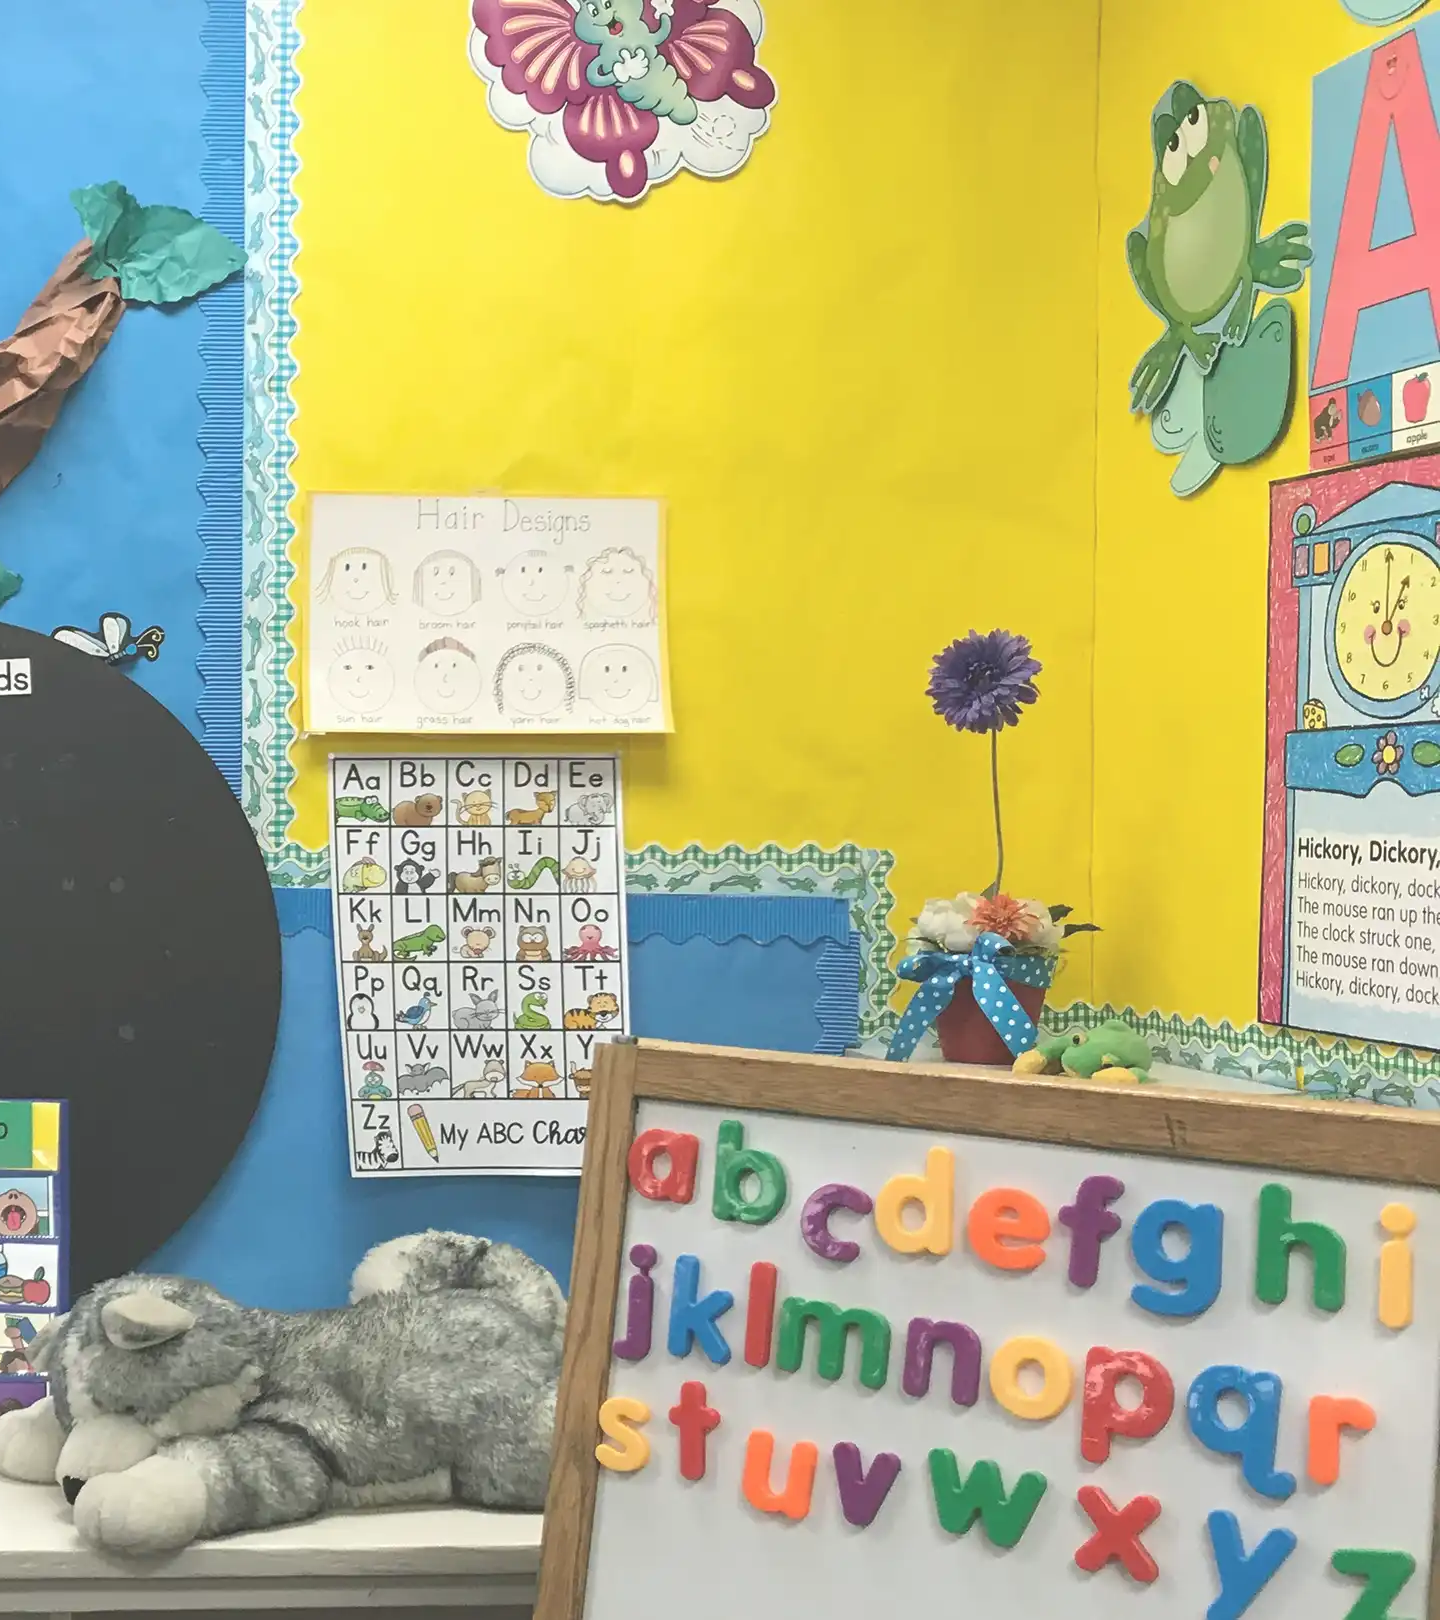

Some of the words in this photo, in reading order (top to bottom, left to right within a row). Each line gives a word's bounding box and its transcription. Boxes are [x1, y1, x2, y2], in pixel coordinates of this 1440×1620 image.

[1406, 429, 1428, 445] apple
[416, 499, 485, 532] Hair
[502, 499, 591, 545] Designs
[1348, 590, 1356, 601] 10
[1431, 577, 1437, 588] 2
[334, 616, 360, 628] hook
[367, 616, 389, 627] hair
[419, 619, 453, 630] broom
[457, 620, 476, 629] hair
[545, 620, 564, 629] hair
[631, 619, 651, 628] hair
[1340, 622, 1346, 633] 9
[1433, 615, 1439, 626] 3
[1346, 652, 1353, 663] 8
[1423, 650, 1429, 660] 4
[1360, 674, 1366, 684] 7
[1383, 681, 1389, 690] 6
[1407, 672, 1413, 683] 5
[337, 714, 355, 723] sun
[361, 714, 383, 724] hair
[417, 715, 448, 729] grass
[453, 715, 473, 724] hair
[343, 763, 381, 791] Aa
[400, 762, 435, 788] Bb
[455, 760, 492, 787] Cc
[514, 762, 549, 788] Dd
[569, 762, 604, 788] Ee
[347, 829, 380, 855] Ff
[401, 830, 436, 861] Gg
[457, 830, 492, 856] Hh
[518, 830, 542, 856] Ii
[571, 829, 601, 861] Jj
[1297, 837, 1363, 866] Hickory,
[1369, 840, 1440, 871] Dickory,
[1298, 871, 1346, 895] Hickory,
[1351, 874, 1402, 899] dickory,
[350, 897, 382, 923] Kk
[453, 897, 501, 923] Mm
[515, 897, 550, 923] Nn
[571, 897, 609, 923] Oo
[1297, 896, 1319, 915] The
[1323, 900, 1368, 919] mouse
[1372, 906, 1395, 921] ran
[1400, 908, 1418, 927] up
[1297, 920, 1319, 940] The
[1322, 923, 1355, 943] clock
[1359, 928, 1401, 948] struck
[1405, 933, 1436, 955] one,
[1297, 944, 1318, 964] The
[1322, 949, 1367, 969] mouse
[1371, 956, 1395, 974] ran
[355, 966, 384, 997] Pp
[402, 965, 442, 997] Qq
[463, 966, 494, 992] Rr
[518, 965, 551, 991] Ss
[574, 965, 608, 991] Tt
[1296, 969, 1344, 996] Hickory,
[1349, 977, 1401, 1004] dickory,
[356, 1034, 387, 1060] Uu
[407, 1034, 439, 1060] Vv
[453, 1034, 504, 1059] Ww
[520, 1033, 553, 1060] Xx
[576, 1033, 594, 1059] Y
[361, 1104, 391, 1131] Zz
[441, 1123, 468, 1151] My
[476, 1122, 524, 1145] ABC
[533, 1120, 587, 1145] Char
[627, 1127, 699, 1205] a
[712, 1119, 787, 1225] b
[800, 1182, 873, 1262] c
[874, 1145, 954, 1256] d
[967, 1187, 1051, 1271] e
[1058, 1175, 1125, 1288] f
[1130, 1199, 1224, 1317] g
[1255, 1182, 1346, 1312] h
[1378, 1202, 1417, 1329] i
[613, 1243, 658, 1361] j
[668, 1253, 734, 1366] k
[775, 1295, 891, 1390] m
[902, 1316, 982, 1407] n
[988, 1335, 1073, 1420] o
[1080, 1346, 1175, 1464] p
[1186, 1364, 1297, 1500] q
[1307, 1394, 1377, 1486] r
[595, 1396, 651, 1473] s
[668, 1380, 721, 1481] t
[742, 1429, 819, 1520] u
[832, 1441, 901, 1527] v
[927, 1447, 1048, 1548] w
[1074, 1485, 1162, 1584] x
[1206, 1509, 1298, 1620] y
[1331, 1548, 1417, 1620] z
